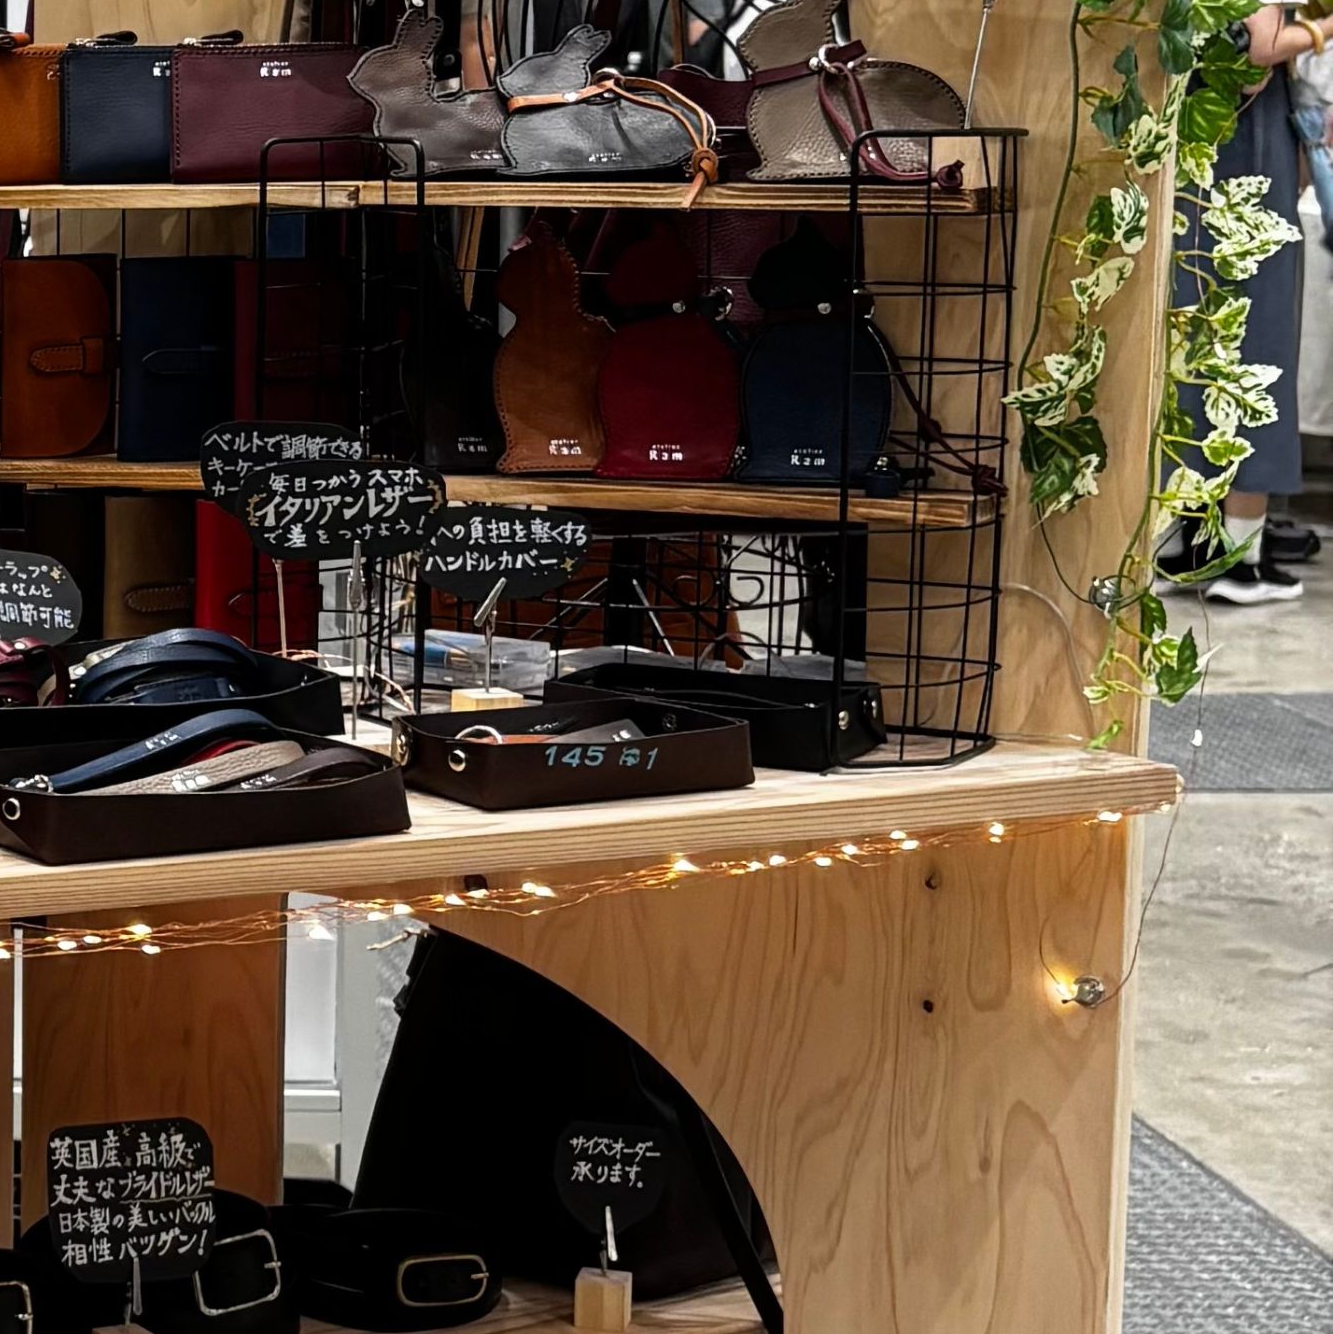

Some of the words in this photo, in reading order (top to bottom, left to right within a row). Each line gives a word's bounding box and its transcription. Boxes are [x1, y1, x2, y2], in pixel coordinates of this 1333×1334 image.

[205, 433, 363, 461] ベルトで調節できる
[649, 450, 683, 462] Ram
[790, 454, 825, 466] Ram
[268, 467, 423, 493] 毎日つかうスマホ
[257, 486, 433, 527] イタリアンレザー
[431, 516, 587, 547] への負担を軽くする
[425, 548, 558, 572] ハンドルカバー
[545, 745, 606, 767] 145
[569, 1135, 661, 1162] サイズオーダー
[50, 1166, 215, 1207] 丈夫なブライドルレザー
[571, 1161, 643, 1188] 承ります。
[58, 1201, 216, 1235] 日本製の美しいバックル
